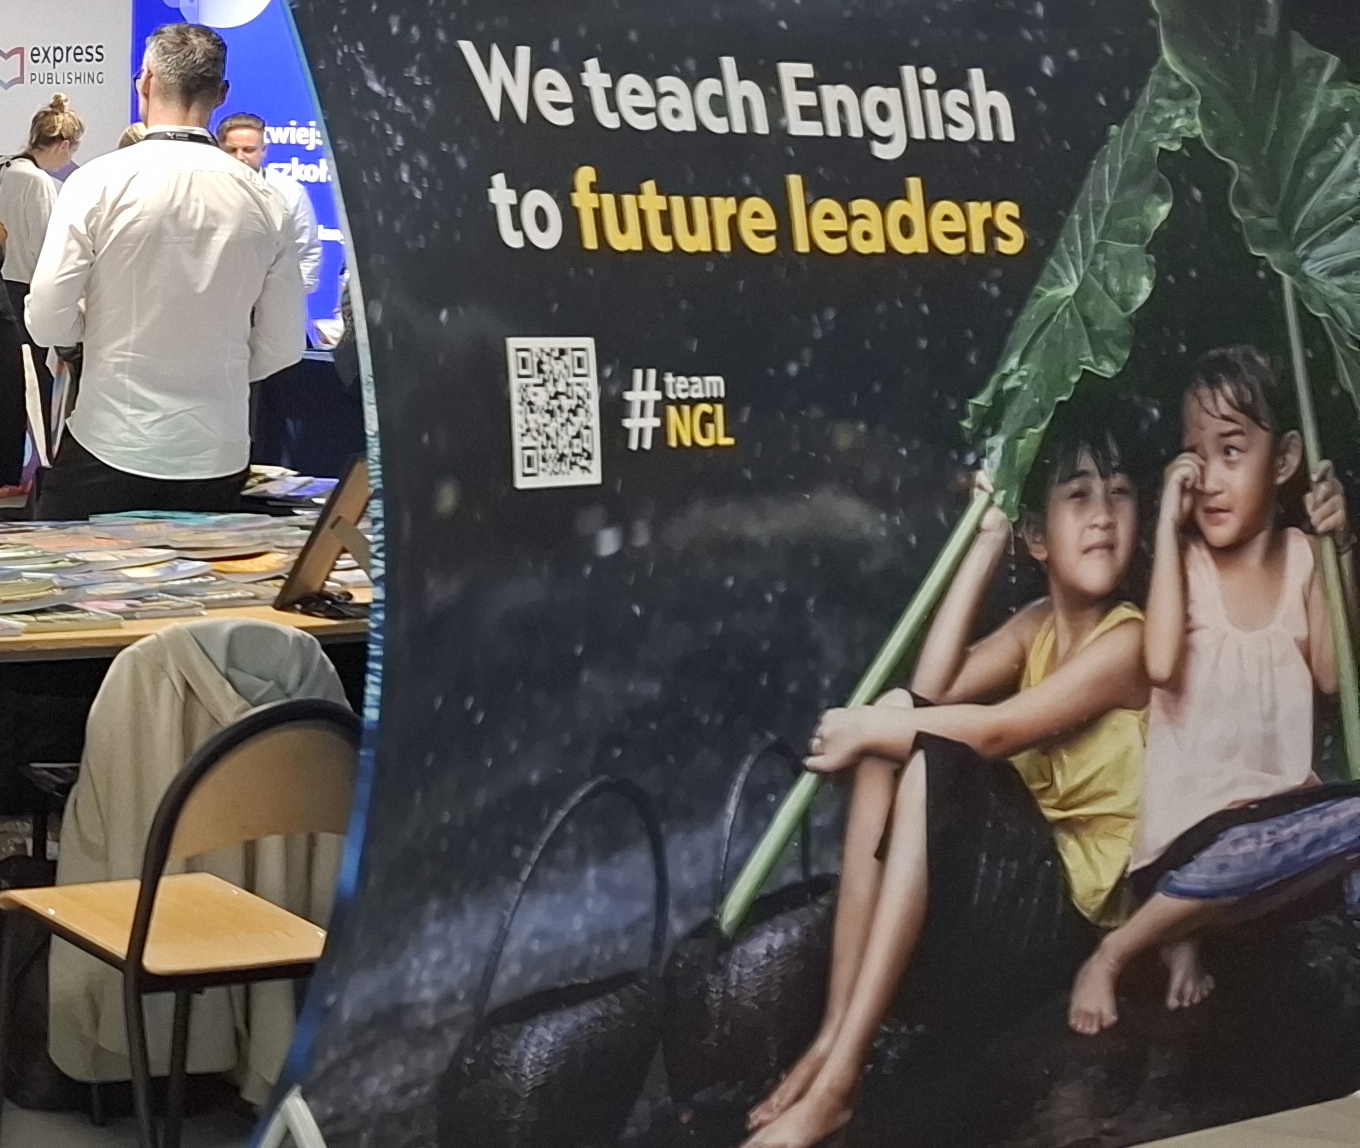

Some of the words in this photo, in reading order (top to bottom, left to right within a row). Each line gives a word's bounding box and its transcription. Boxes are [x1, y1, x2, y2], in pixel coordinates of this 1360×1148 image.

[30, 43, 105, 69] express
[30, 71, 105, 85] PUBLISHING
[457, 39, 575, 127] We
[580, 56, 770, 135] teach
[777, 62, 1016, 160] English
[488, 171, 563, 250] to
[571, 165, 778, 253] future
[786, 173, 1027, 256] leaders
[666, 402, 736, 448] NGL
